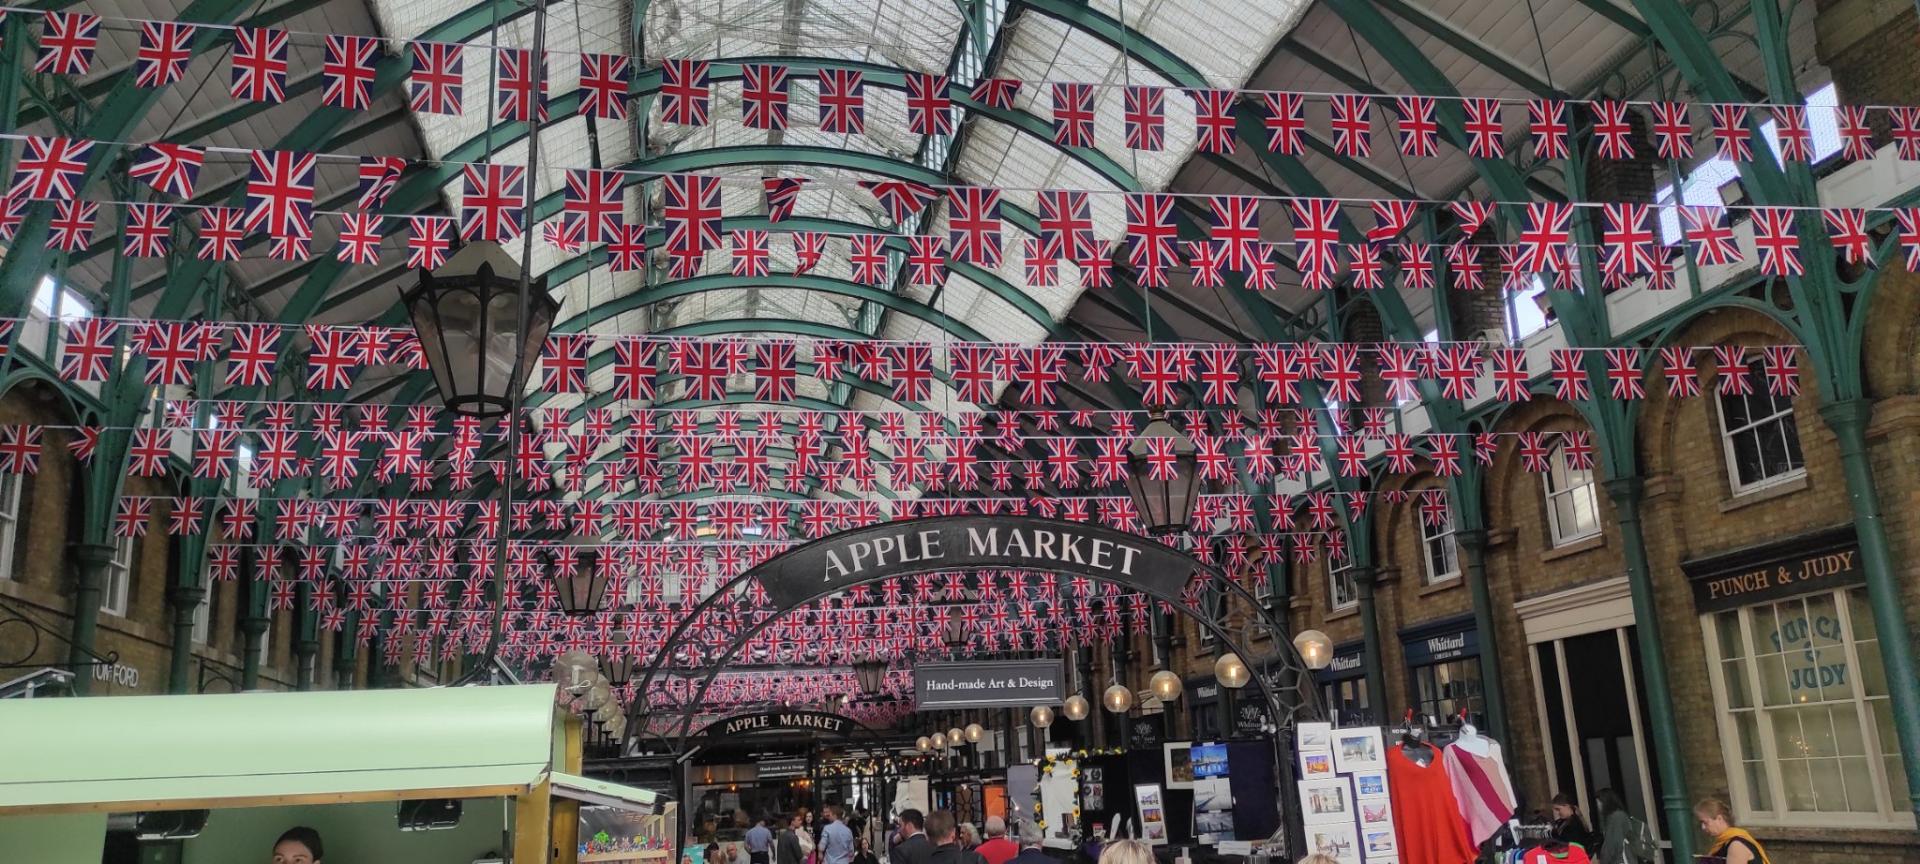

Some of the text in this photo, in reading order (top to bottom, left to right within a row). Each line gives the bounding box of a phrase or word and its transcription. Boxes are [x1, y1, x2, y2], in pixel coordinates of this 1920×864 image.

[824, 527, 1142, 583] APPLE MARKET
[1707, 551, 1856, 600] PUNCH & JUDY
[1427, 633, 1465, 653] Whittard
[1330, 652, 1361, 672] Whittard
[113, 664, 139, 687] FORD
[926, 676, 1054, 691] Hand-made Art & Design
[1790, 663, 1846, 690] JUDY
[726, 714, 844, 734] APPLE MARKET
